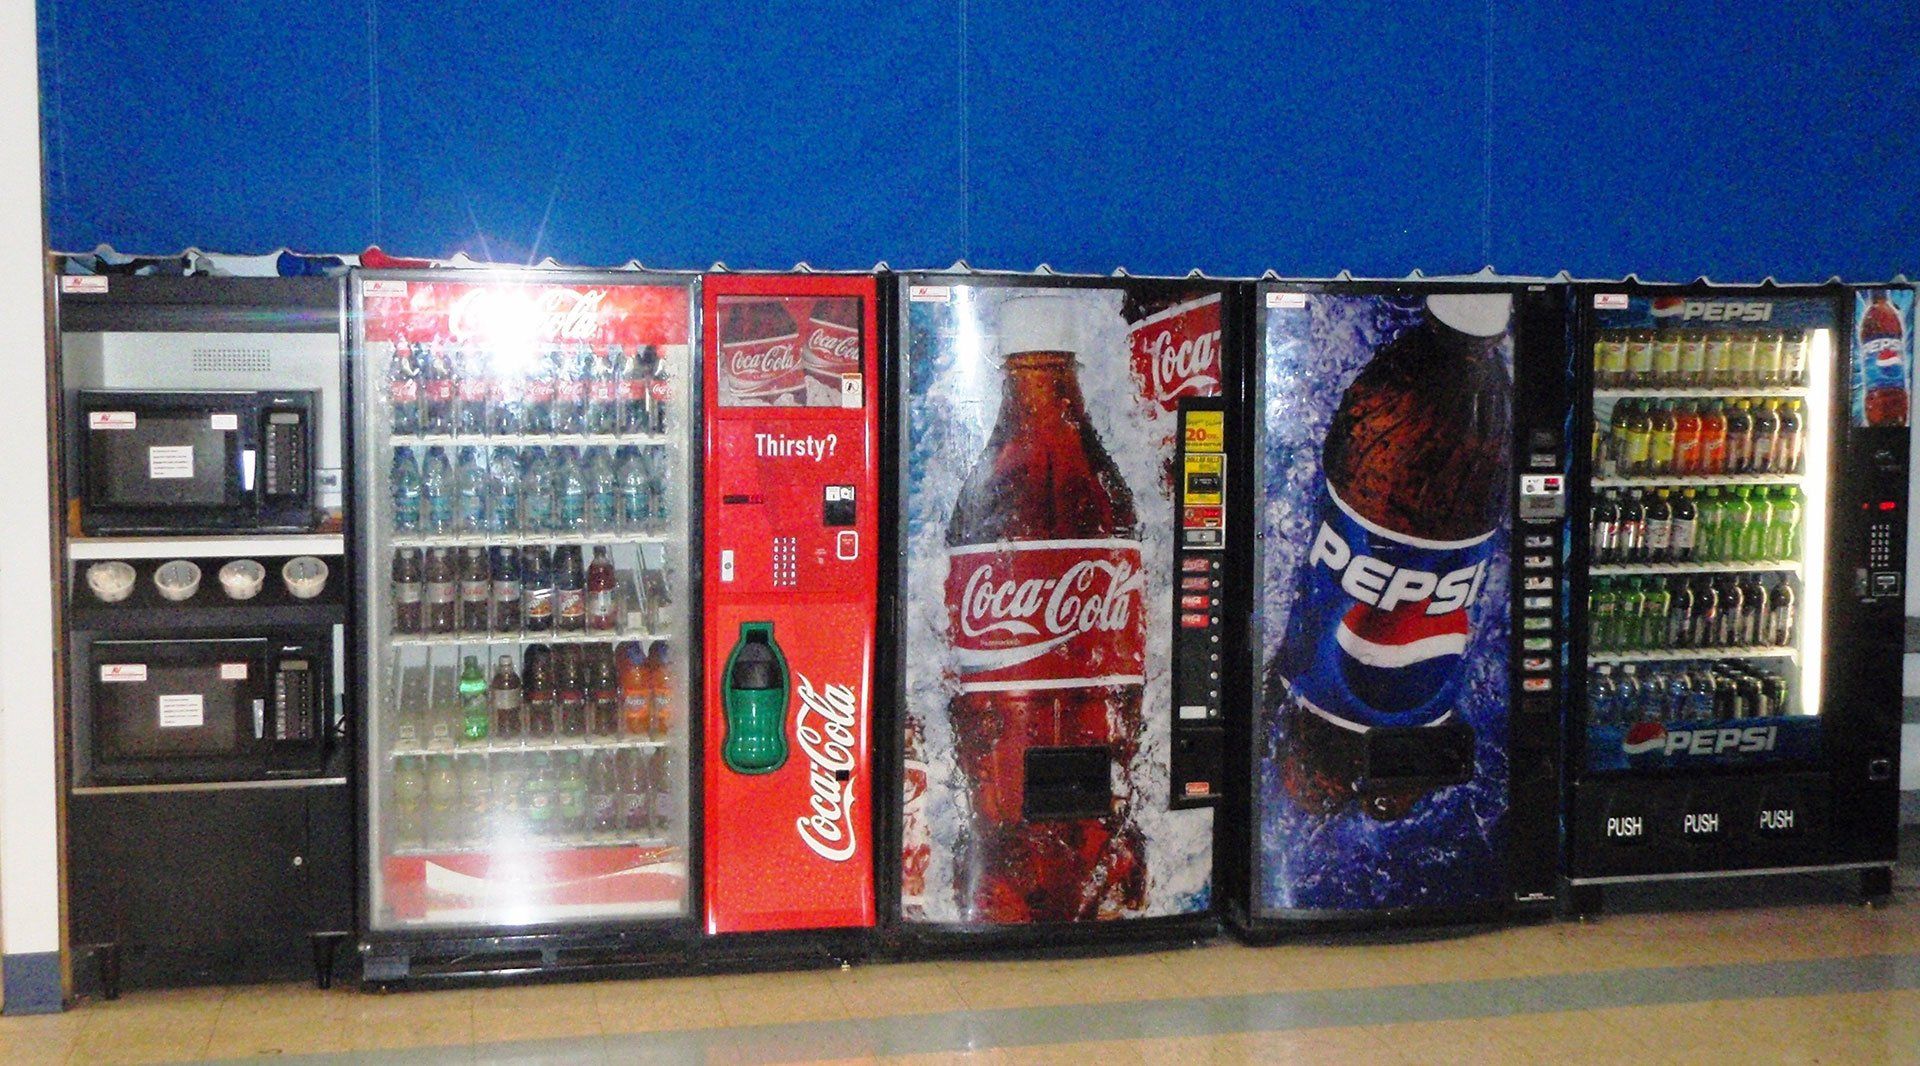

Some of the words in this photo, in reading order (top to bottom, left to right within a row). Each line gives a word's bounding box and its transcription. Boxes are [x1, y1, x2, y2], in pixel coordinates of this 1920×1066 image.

[1683, 302, 1773, 321] PEPSI
[731, 344, 794, 375] Coca-Cola
[755, 433, 838, 463] Thirsty?
[1186, 428, 1207, 441] 20
[1310, 521, 1487, 615] PEPSI
[961, 560, 1133, 637] Coca-Cola
[1663, 726, 1778, 756] PEPSI
[796, 672, 856, 861] Coca-Cola
[1607, 817, 1642, 836] PUSH
[1684, 814, 1718, 833] PUSH
[1760, 810, 1793, 828] PUSH
